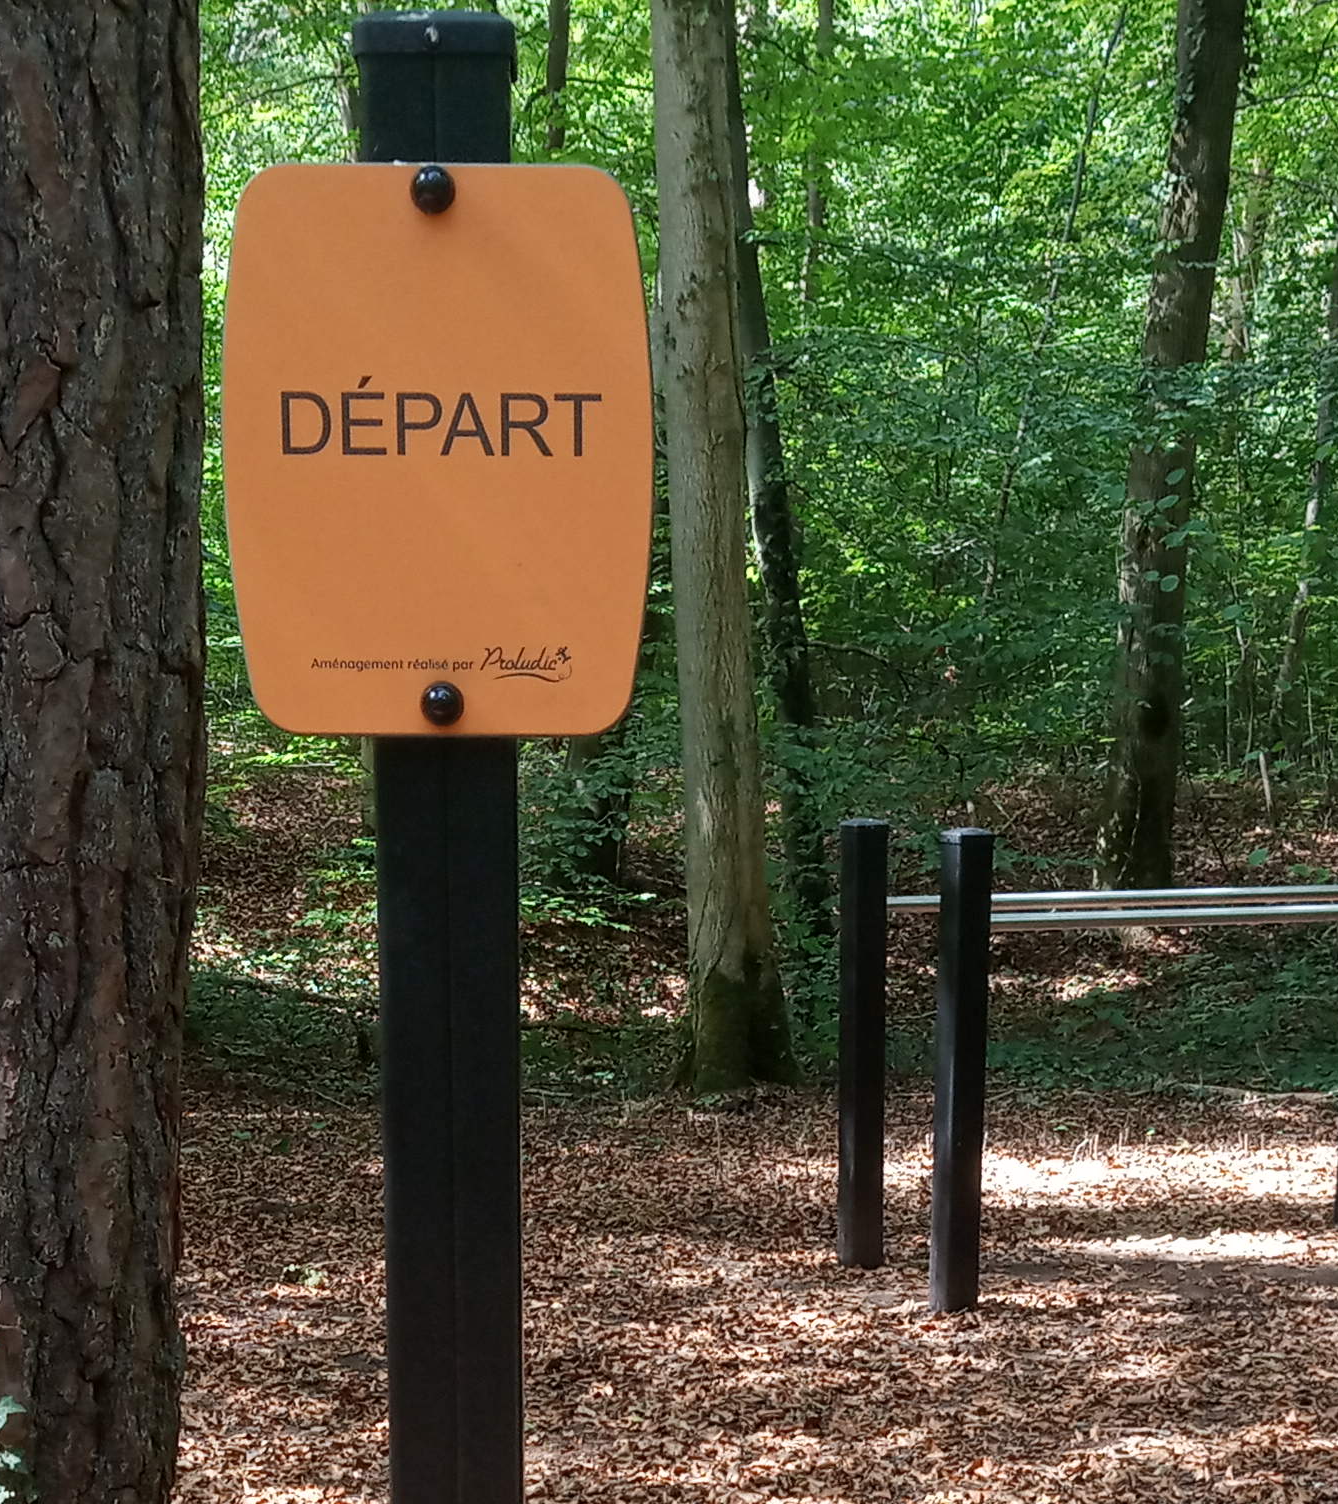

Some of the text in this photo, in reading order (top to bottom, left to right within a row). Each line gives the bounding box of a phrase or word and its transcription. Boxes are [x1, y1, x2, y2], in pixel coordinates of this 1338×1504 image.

[280, 376, 602, 457] DÉPART
[311, 646, 558, 673] Aménagement réalisé par Proludic
